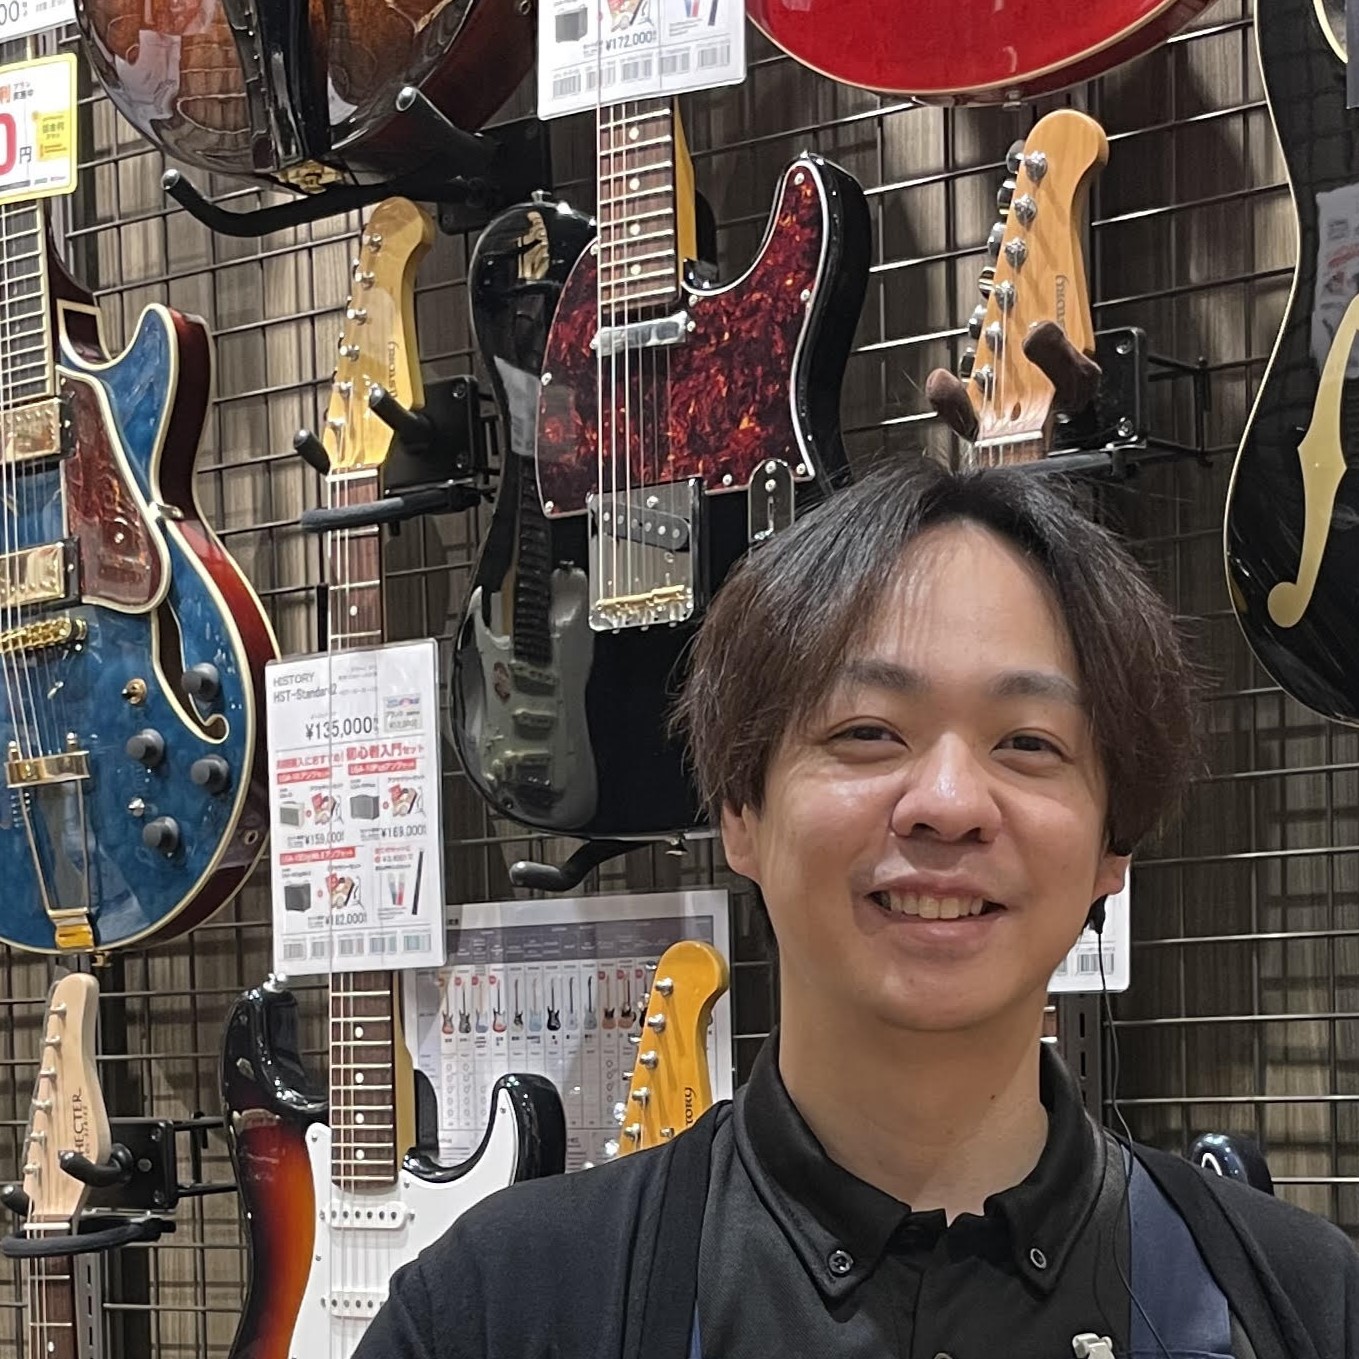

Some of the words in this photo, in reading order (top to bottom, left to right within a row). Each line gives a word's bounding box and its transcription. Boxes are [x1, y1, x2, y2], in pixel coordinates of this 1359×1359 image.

[19, 145, 32, 164] 円
[305, 715, 374, 741] ¥135,000
[72, 1086, 84, 1155] HECTER
[684, 1087, 697, 1126] TORY
